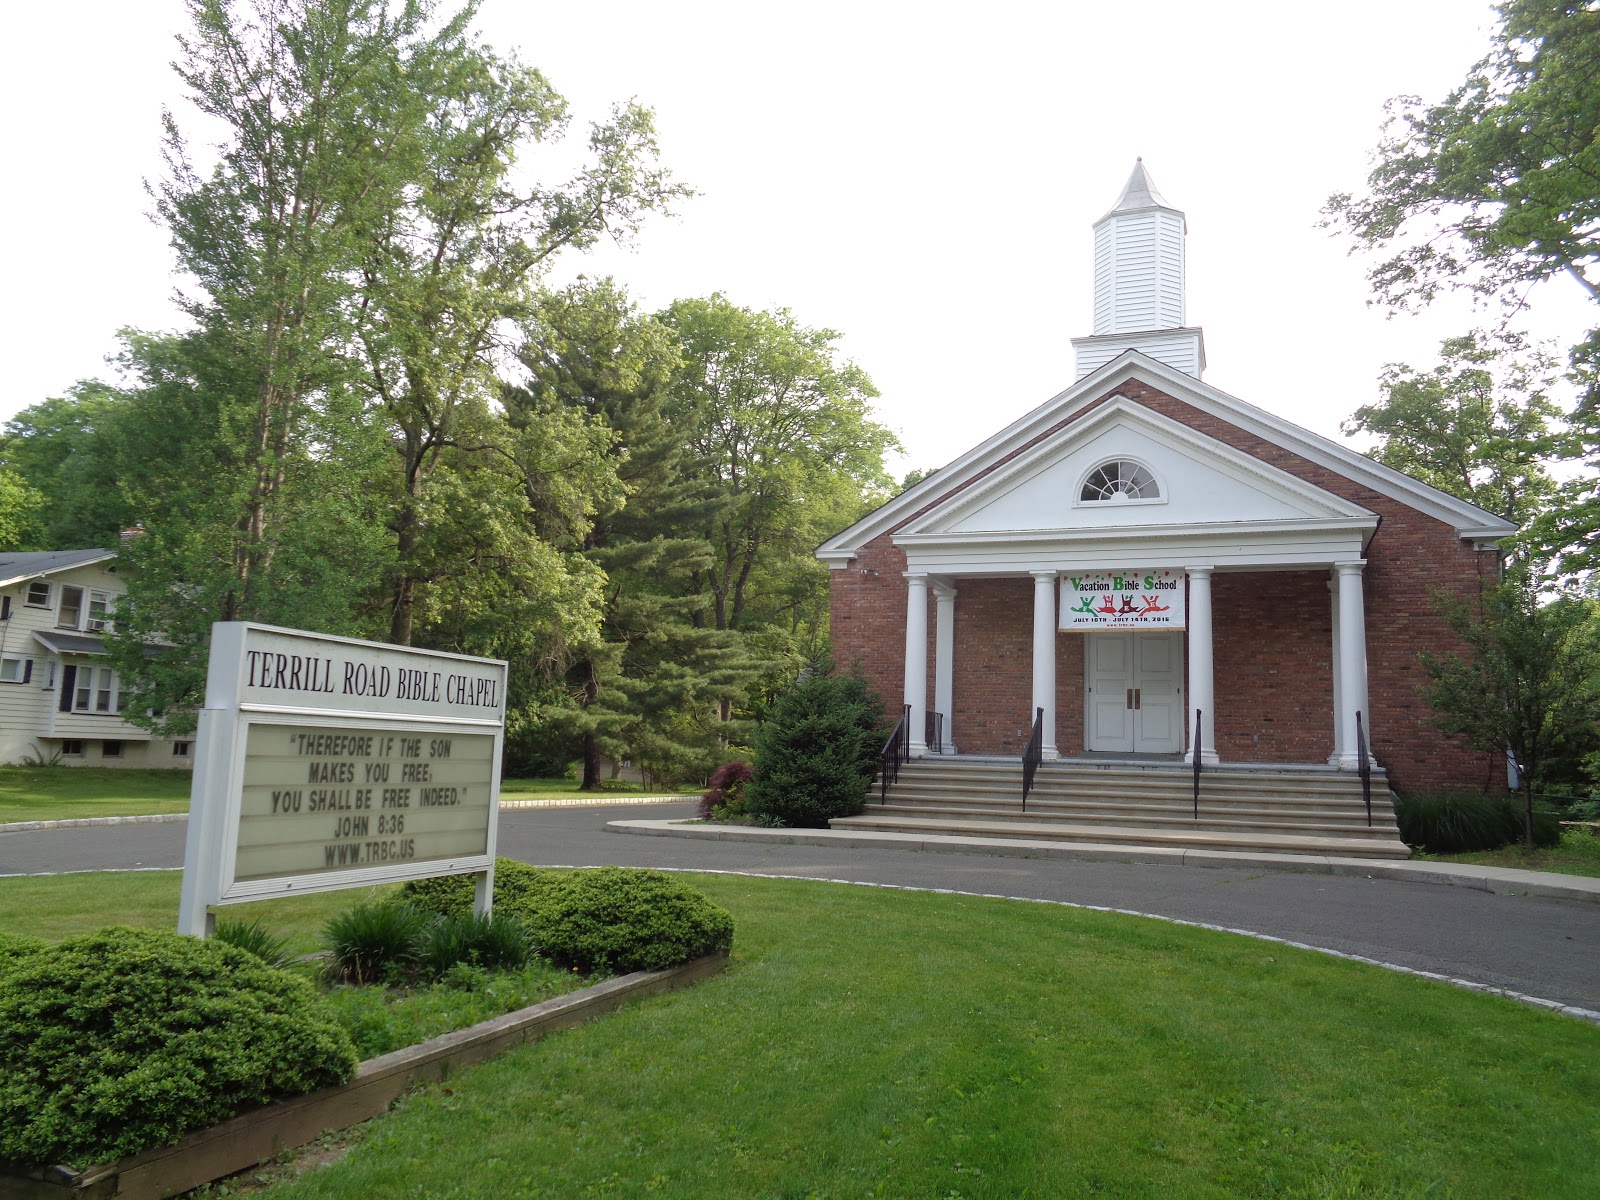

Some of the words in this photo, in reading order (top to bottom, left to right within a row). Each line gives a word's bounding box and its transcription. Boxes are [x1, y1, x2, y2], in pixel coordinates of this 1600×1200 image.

[1070, 577, 1110, 591] Vacation
[1112, 576, 1140, 591] Bible
[1143, 575, 1177, 590] School
[247, 650, 335, 694] TERRILL
[342, 661, 390, 698] ROAD
[396, 668, 441, 702] BIBLE
[446, 674, 499, 708] CHAPEL
[379, 737, 394, 757] IF
[400, 738, 422, 757] THE
[430, 740, 452, 758] SON
[308, 762, 355, 784] MAKES
[365, 763, 390, 783] YOU
[271, 790, 303, 813] YOU
[308, 789, 351, 811] SHALL
[355, 789, 372, 810] BE
[382, 788, 411, 808] FREE
[334, 817, 369, 838] JOHN
[378, 814, 404, 835] 8:36
[324, 839, 415, 867] WWW.TRBC.US
